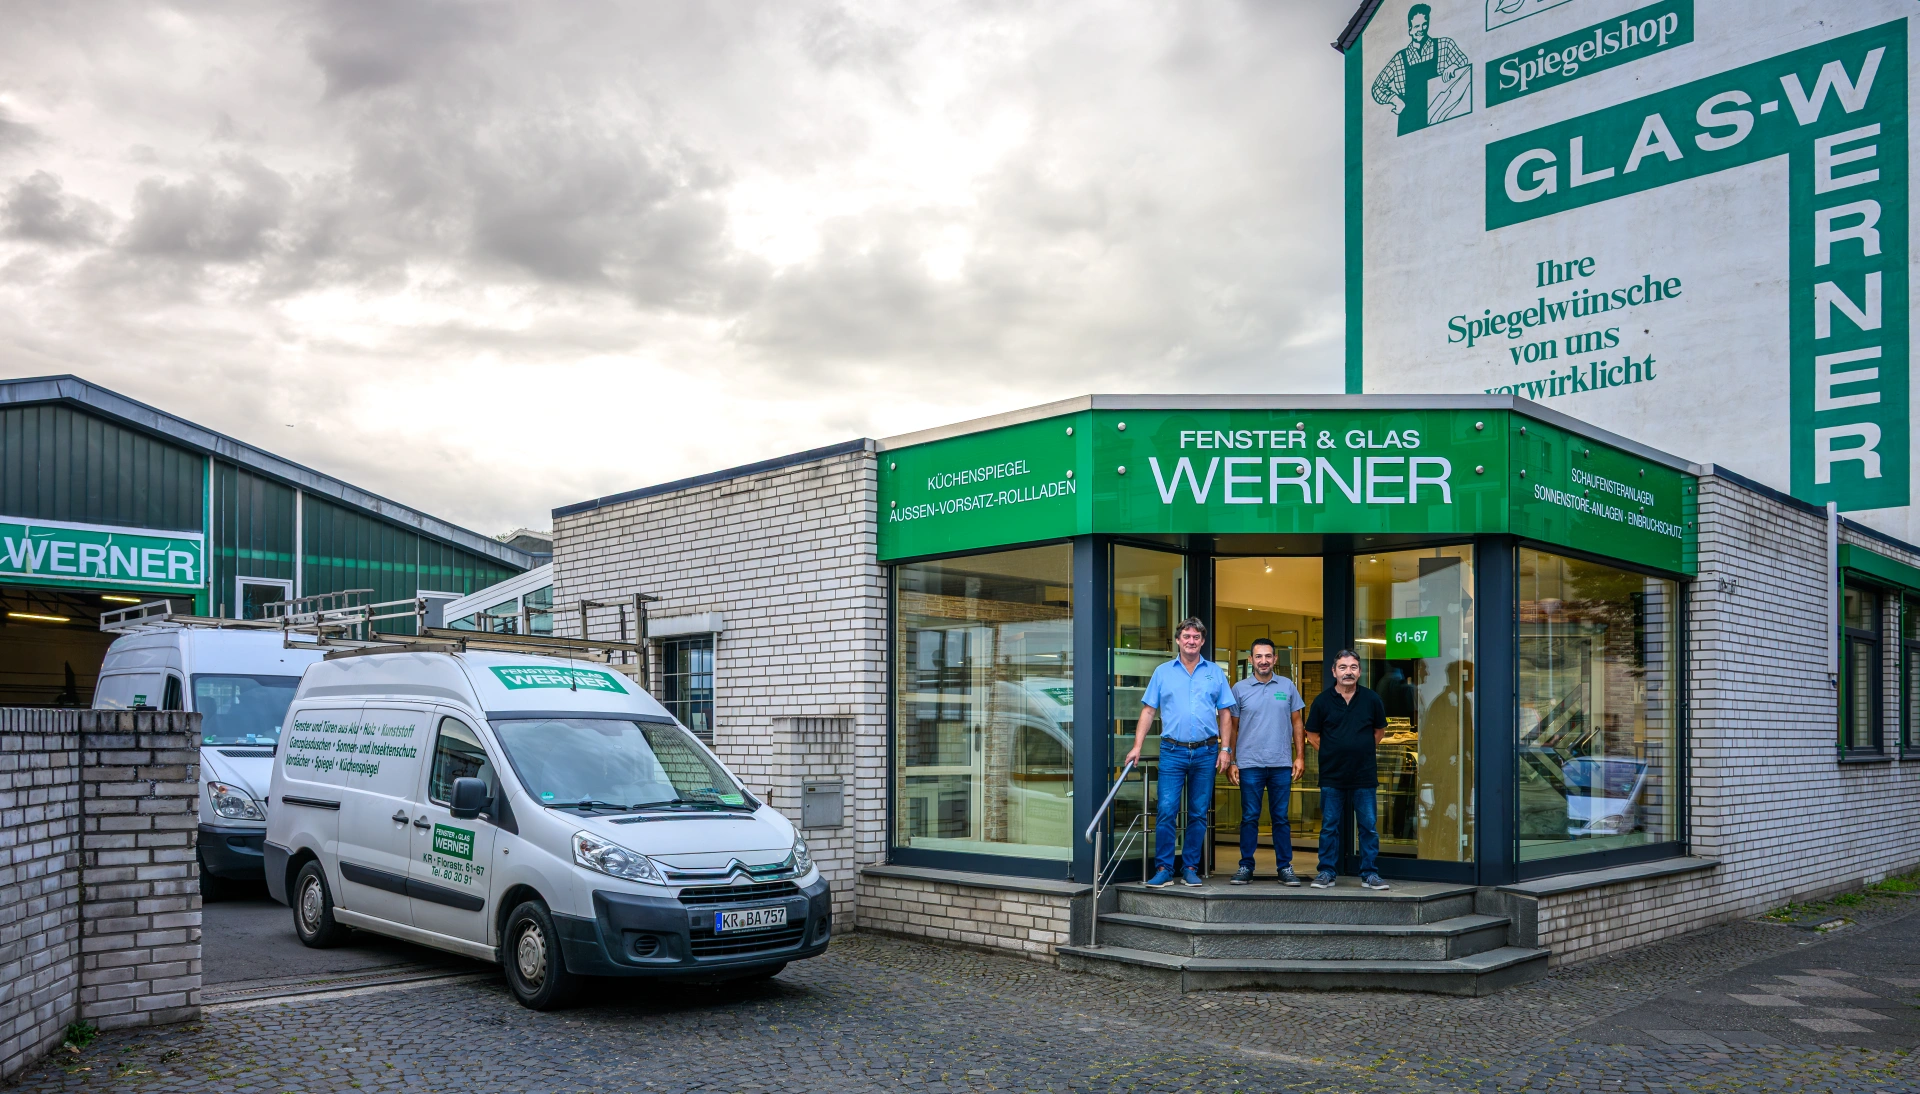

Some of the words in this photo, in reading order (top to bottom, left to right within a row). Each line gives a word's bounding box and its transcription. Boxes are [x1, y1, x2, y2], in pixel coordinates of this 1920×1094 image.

[1499, 12, 1678, 92] Spiegelshop
[1536, 256, 1596, 288] Ihre
[1447, 274, 1682, 348] Spiegelwünsche
[1509, 336, 1558, 366] von
[1564, 327, 1620, 356] uns
[1484, 353, 1657, 401] rwirklicht
[1180, 430, 1306, 449] FENSTER
[1316, 430, 1337, 449] &
[1345, 430, 1420, 449] GLAS
[927, 459, 1030, 491] KÜCHENSPIEGEL
[1148, 457, 1452, 504] WERNER
[1571, 468, 1654, 507] SCHAUFENSTERANLAGEN
[889, 480, 1076, 522] AUSSEN-VORSATZ-ROLLLADEN
[1534, 484, 1623, 522] SONNENSTORE-ANLAGEN
[1627, 511, 1682, 539] EINBRUCHSCHUTZ
[4, 537, 194, 581] WERNER
[1395, 630, 1428, 643] 61-67
[505, 675, 615, 689] WERNER
[293, 720, 312, 732] Fenster
[312, 721, 322, 732] und
[322, 720, 338, 733] Türen
[338, 724, 348, 734] aus
[348, 722, 359, 734] Alu
[362, 723, 377, 735] Holz
[381, 724, 415, 738] Kunststoff
[289, 736, 332, 752] Ganzglasduschen
[359, 741, 372, 754] und
[371, 741, 417, 758] Insektenschutz
[285, 754, 310, 767] Vordächer
[314, 755, 335, 772] Spiegel
[339, 758, 380, 777] Küchenspiegel
[435, 837, 469, 855] WERNER
[436, 828, 455, 839] FENSTER
[458, 833, 470, 842] GLAS
[423, 853, 433, 863] KR
[437, 856, 464, 872] Florastr.
[465, 863, 484, 876] 61-67
[432, 866, 443, 877] Tel.
[443, 869, 452, 880] 80
[453, 872, 462, 882] 30
[463, 875, 472, 885] 91
[723, 913, 738, 928] KR
[747, 911, 762, 926] BA
[764, 909, 784, 924] 757
